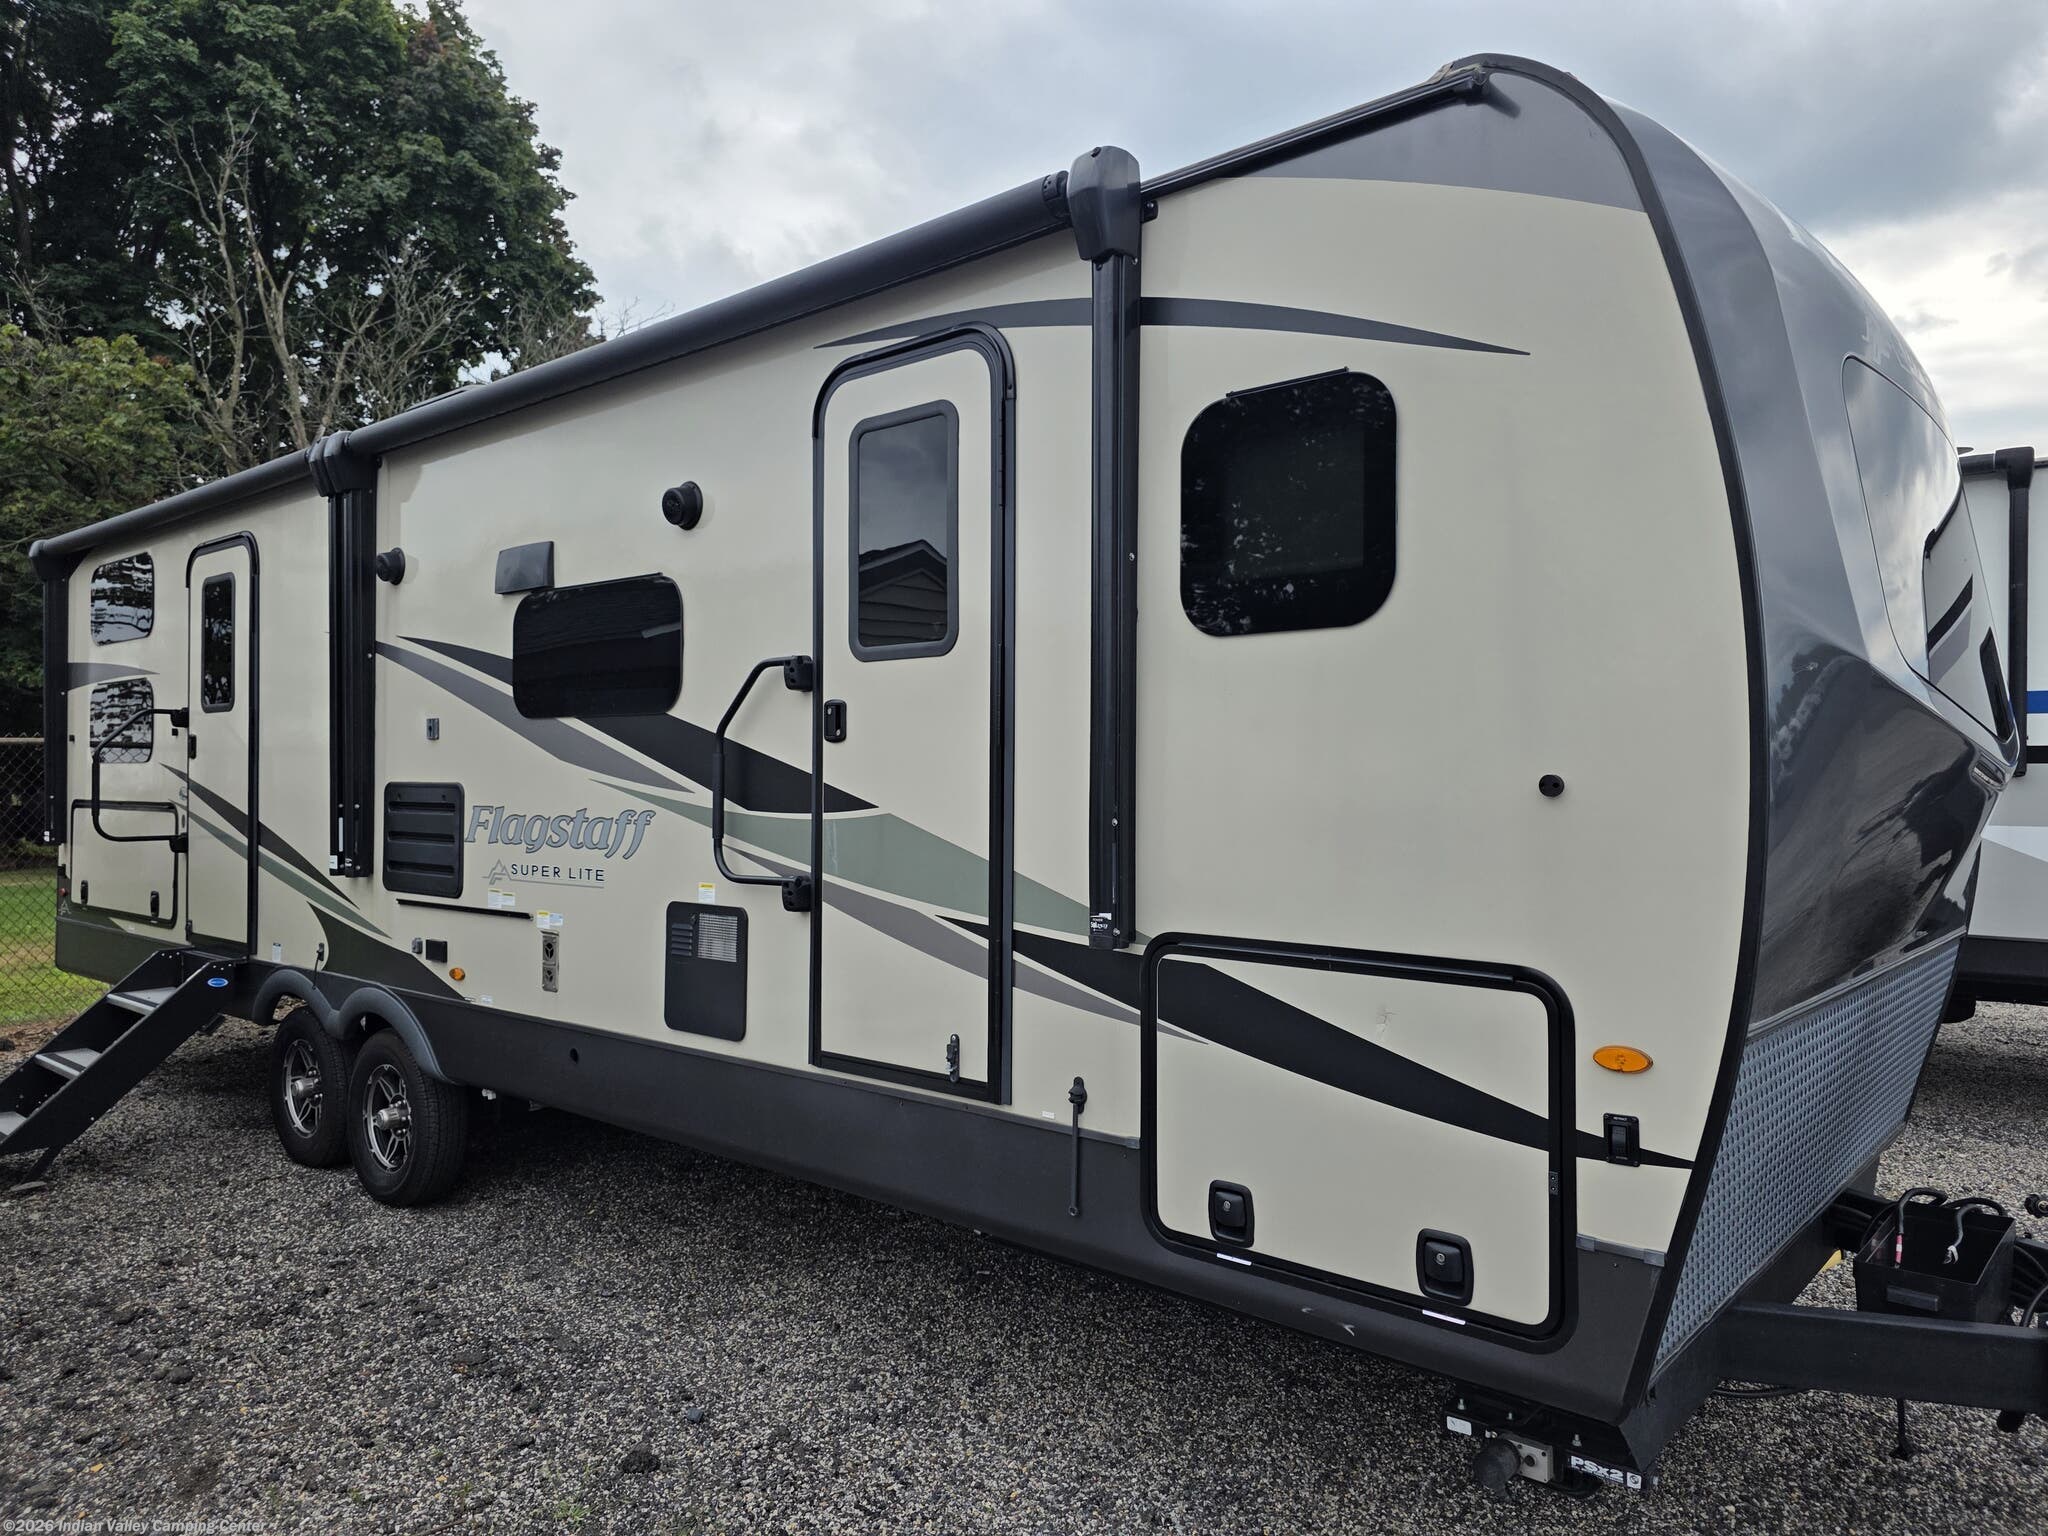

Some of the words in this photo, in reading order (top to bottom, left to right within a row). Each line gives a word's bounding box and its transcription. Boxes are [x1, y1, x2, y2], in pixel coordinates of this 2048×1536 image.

[464, 805, 657, 860] Flagstaff
[511, 863, 561, 878] SUPER
[568, 867, 605, 882] LITE
